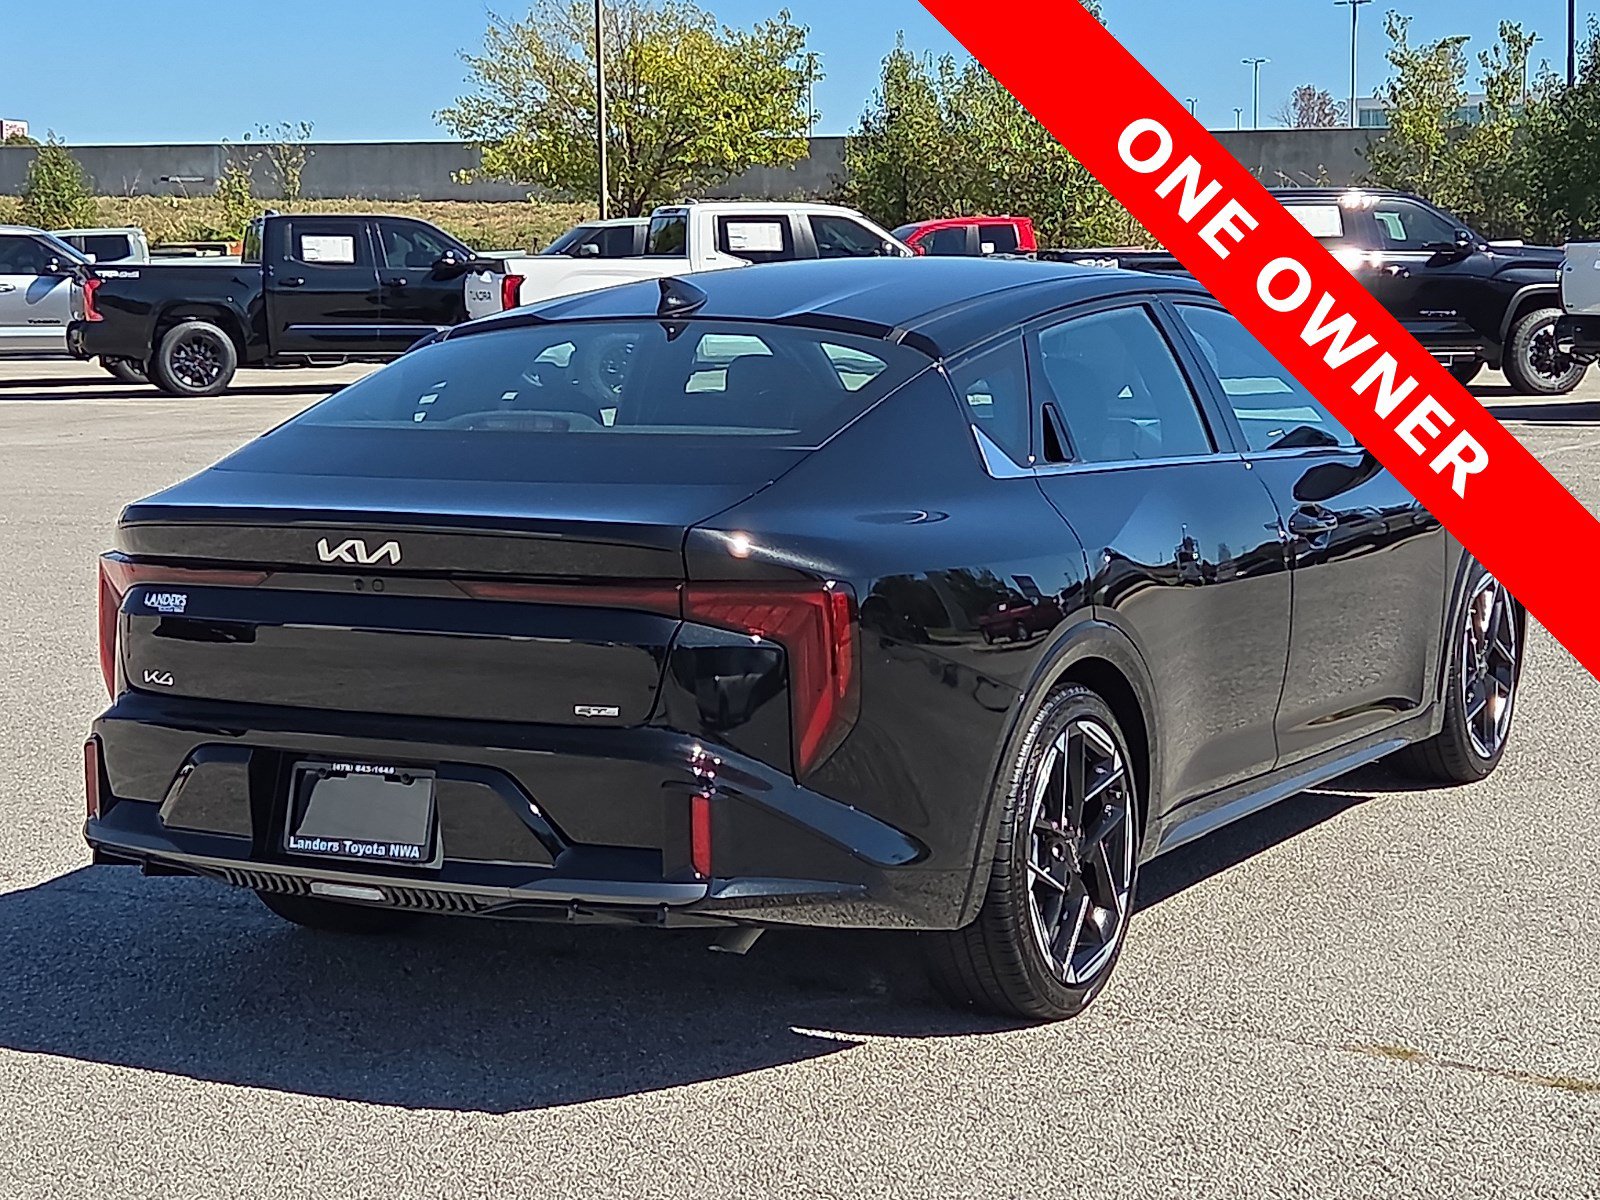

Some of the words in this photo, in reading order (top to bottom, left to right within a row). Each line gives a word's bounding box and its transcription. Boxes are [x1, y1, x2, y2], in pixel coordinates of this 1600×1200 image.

[317, 538, 401, 565] KIA
[144, 592, 187, 608] LANDERS
[143, 669, 174, 686] K4
[289, 835, 340, 852] Landers
[343, 840, 386, 857] Toyota
[389, 844, 420, 859] NWA
